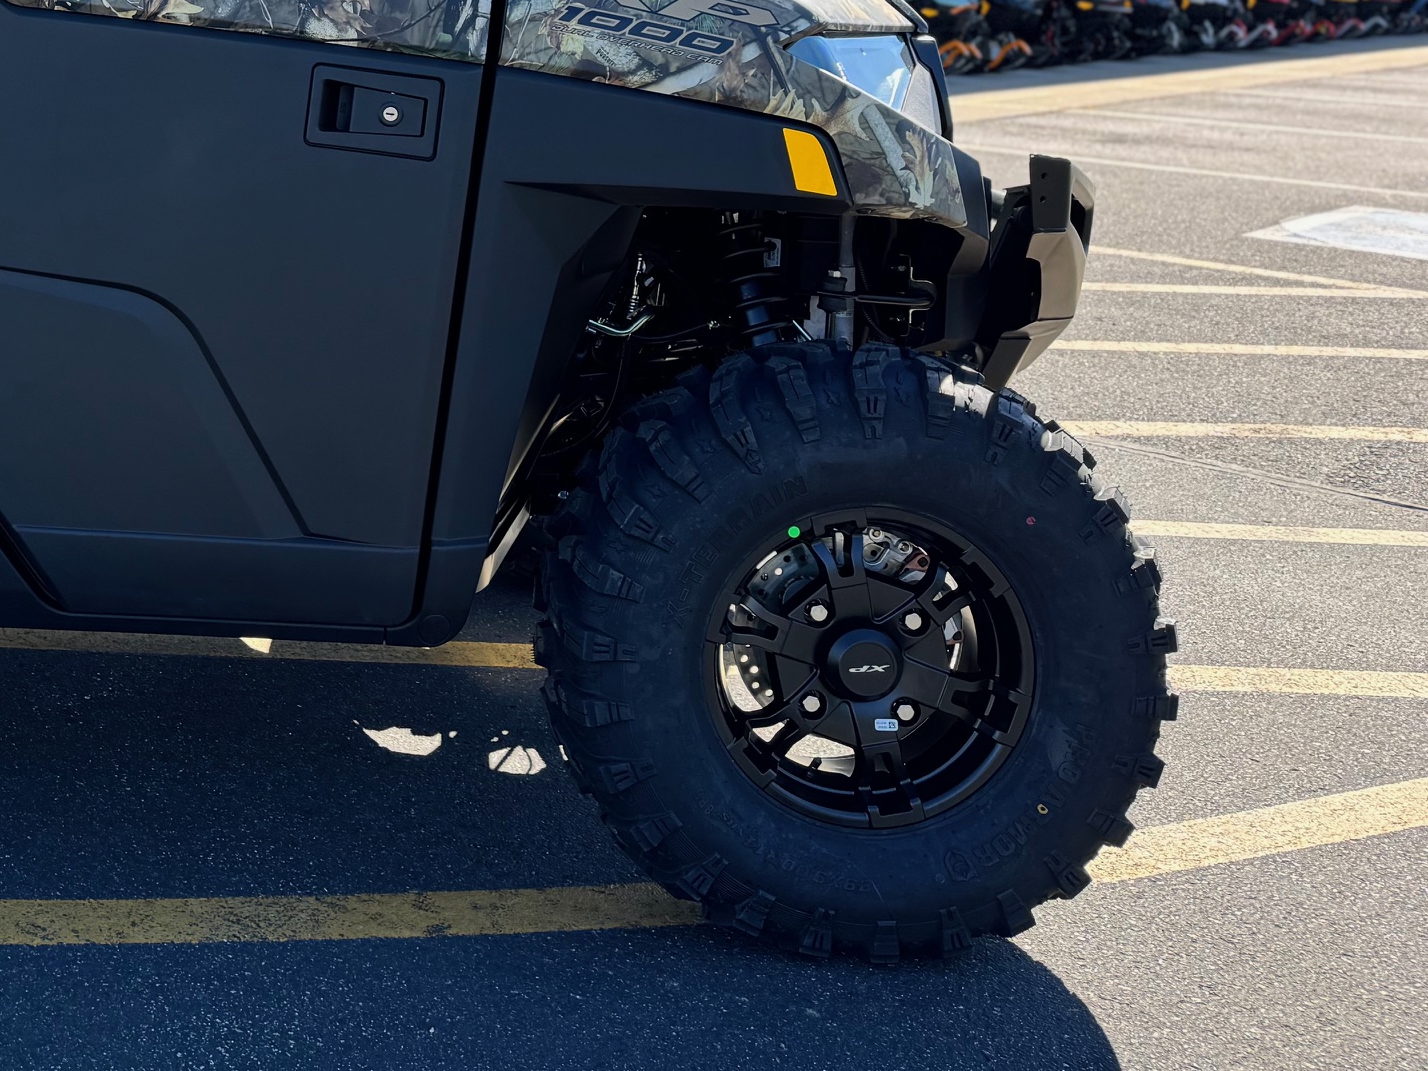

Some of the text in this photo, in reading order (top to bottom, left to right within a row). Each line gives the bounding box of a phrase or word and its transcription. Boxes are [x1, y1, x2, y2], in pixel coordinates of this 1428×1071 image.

[552, 22, 724, 65] DUAL OVERHEAD CAM
[553, 5, 740, 56] 1000
[664, 474, 809, 626] X-TERRAIN
[848, 663, 891, 674] XP
[1059, 725, 1096, 785] PRO
